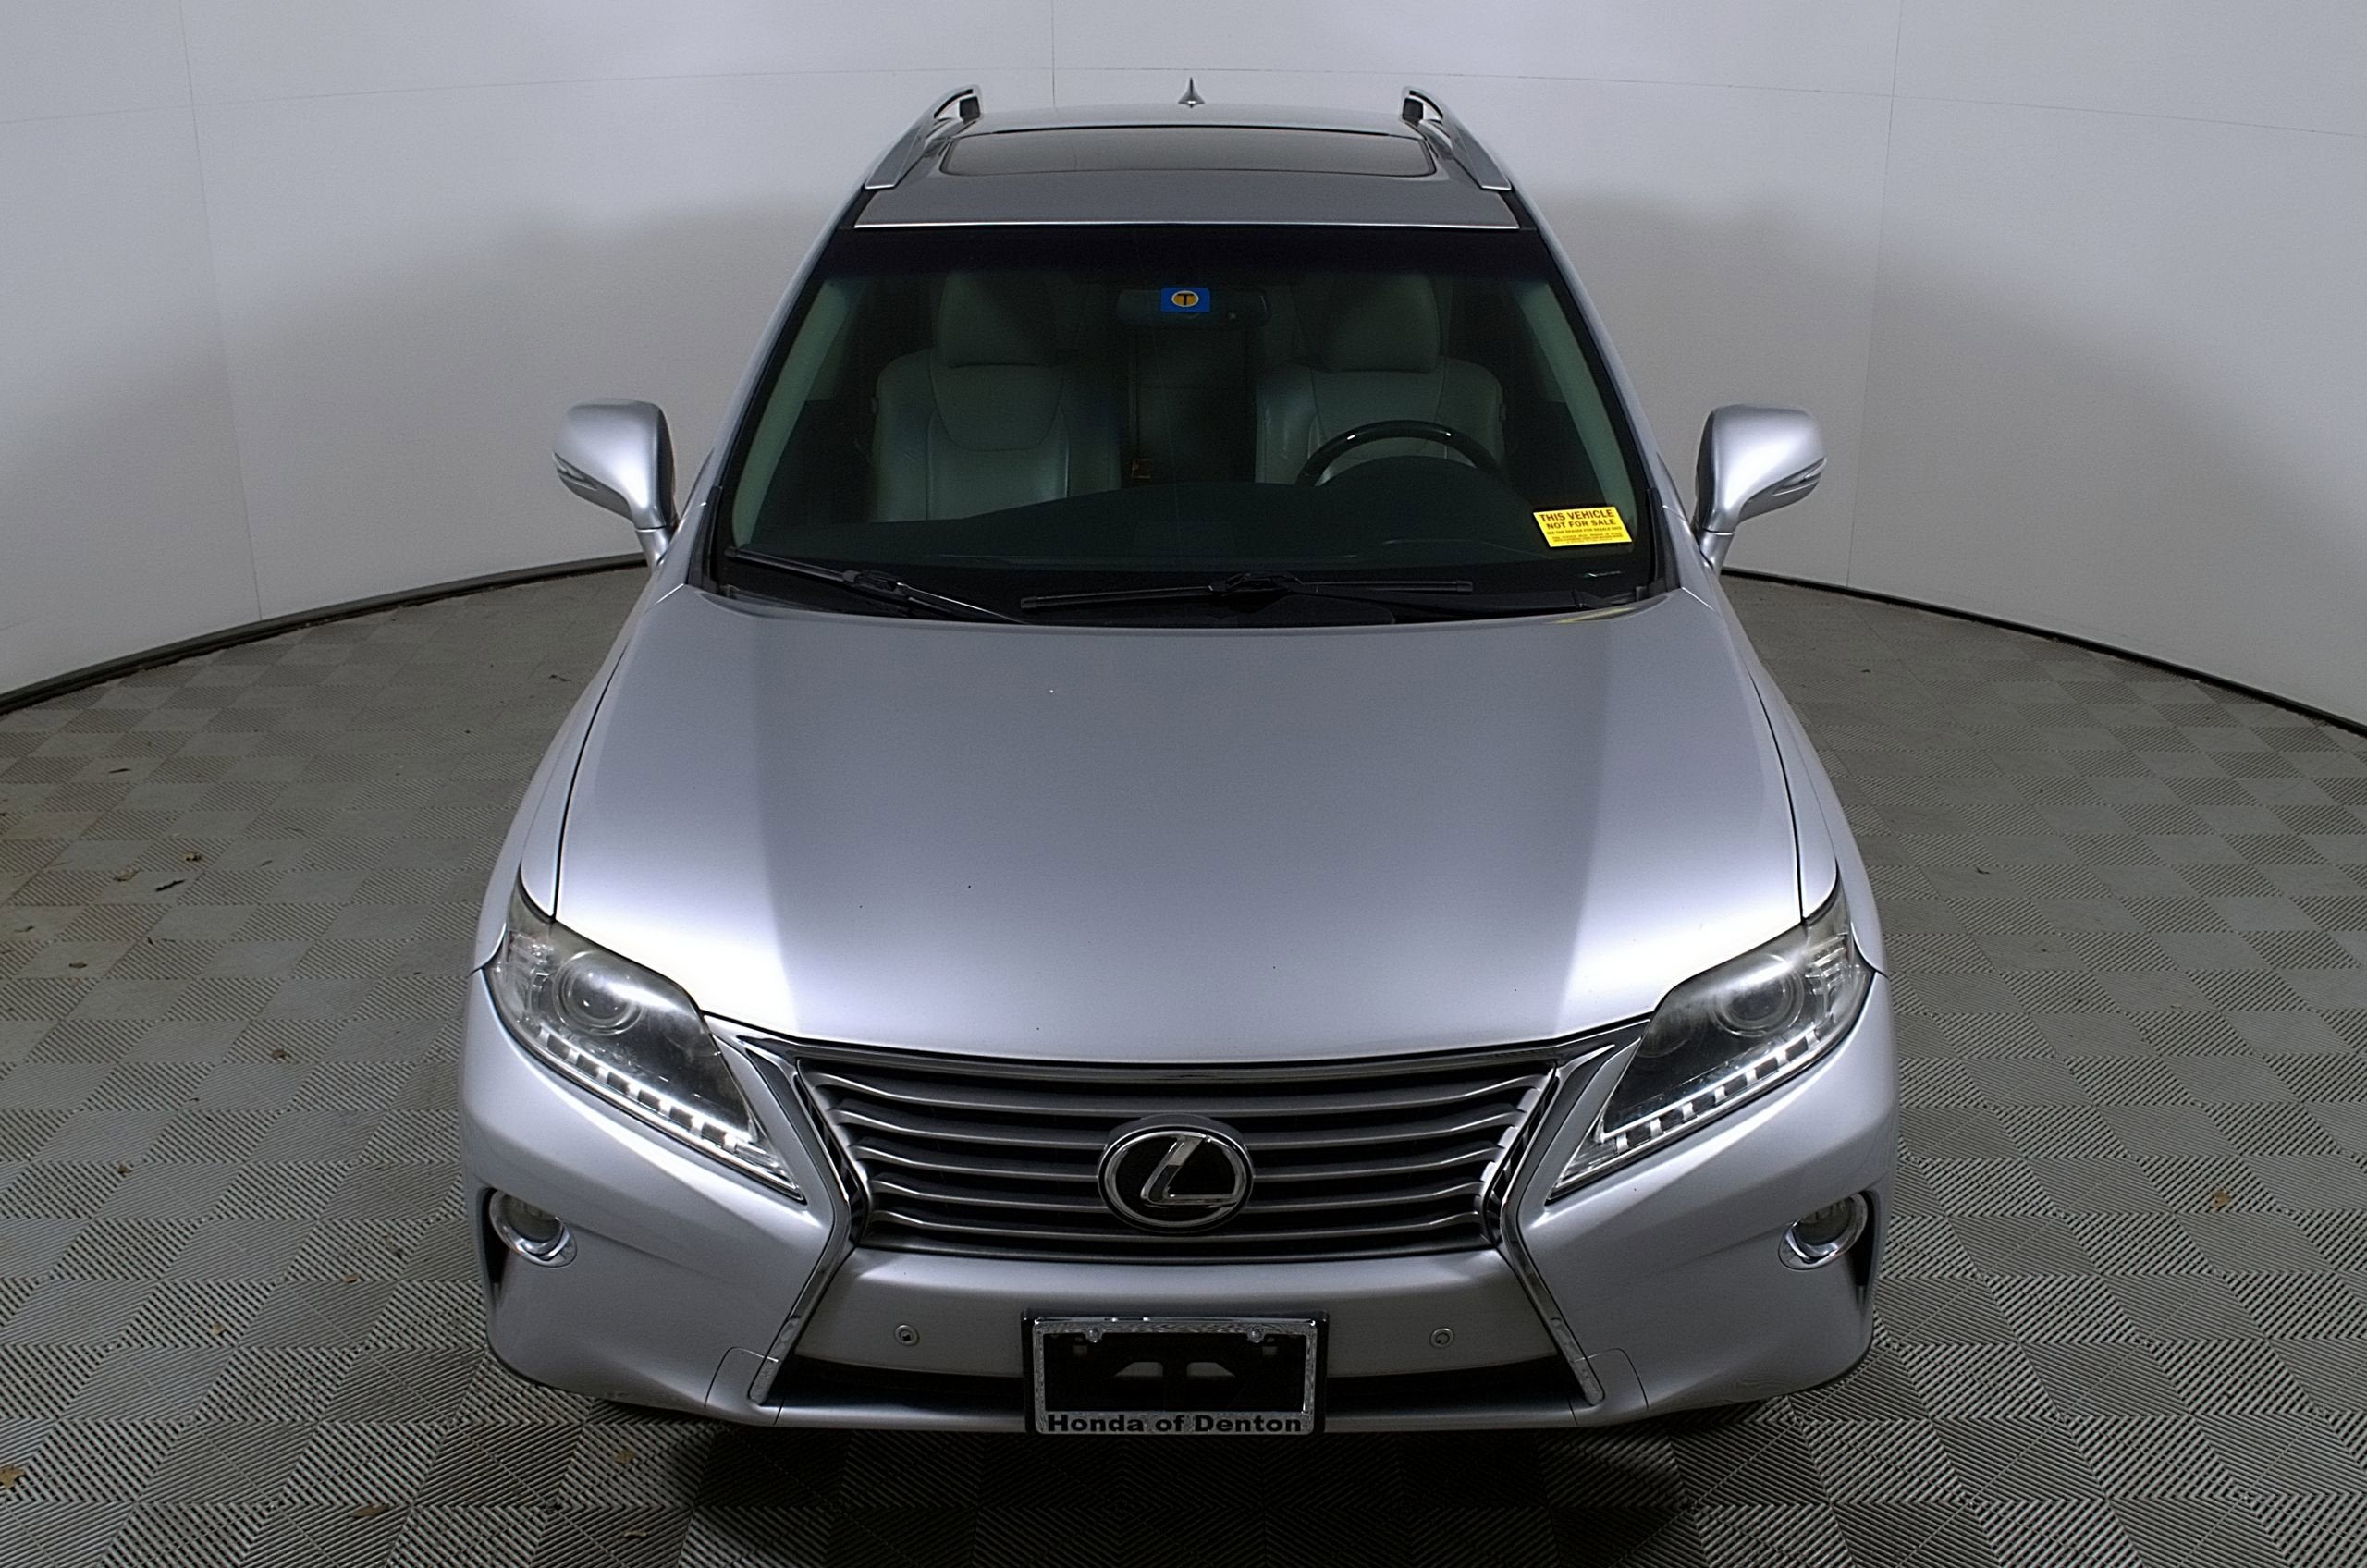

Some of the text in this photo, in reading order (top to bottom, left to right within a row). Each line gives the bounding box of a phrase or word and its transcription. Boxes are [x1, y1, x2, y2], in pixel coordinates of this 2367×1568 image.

[1539, 509, 1615, 522] THIS VEHICLE
[1546, 518, 1616, 530] NOT FOR SALE
[1047, 1414, 1302, 1433] Honda of Denton
